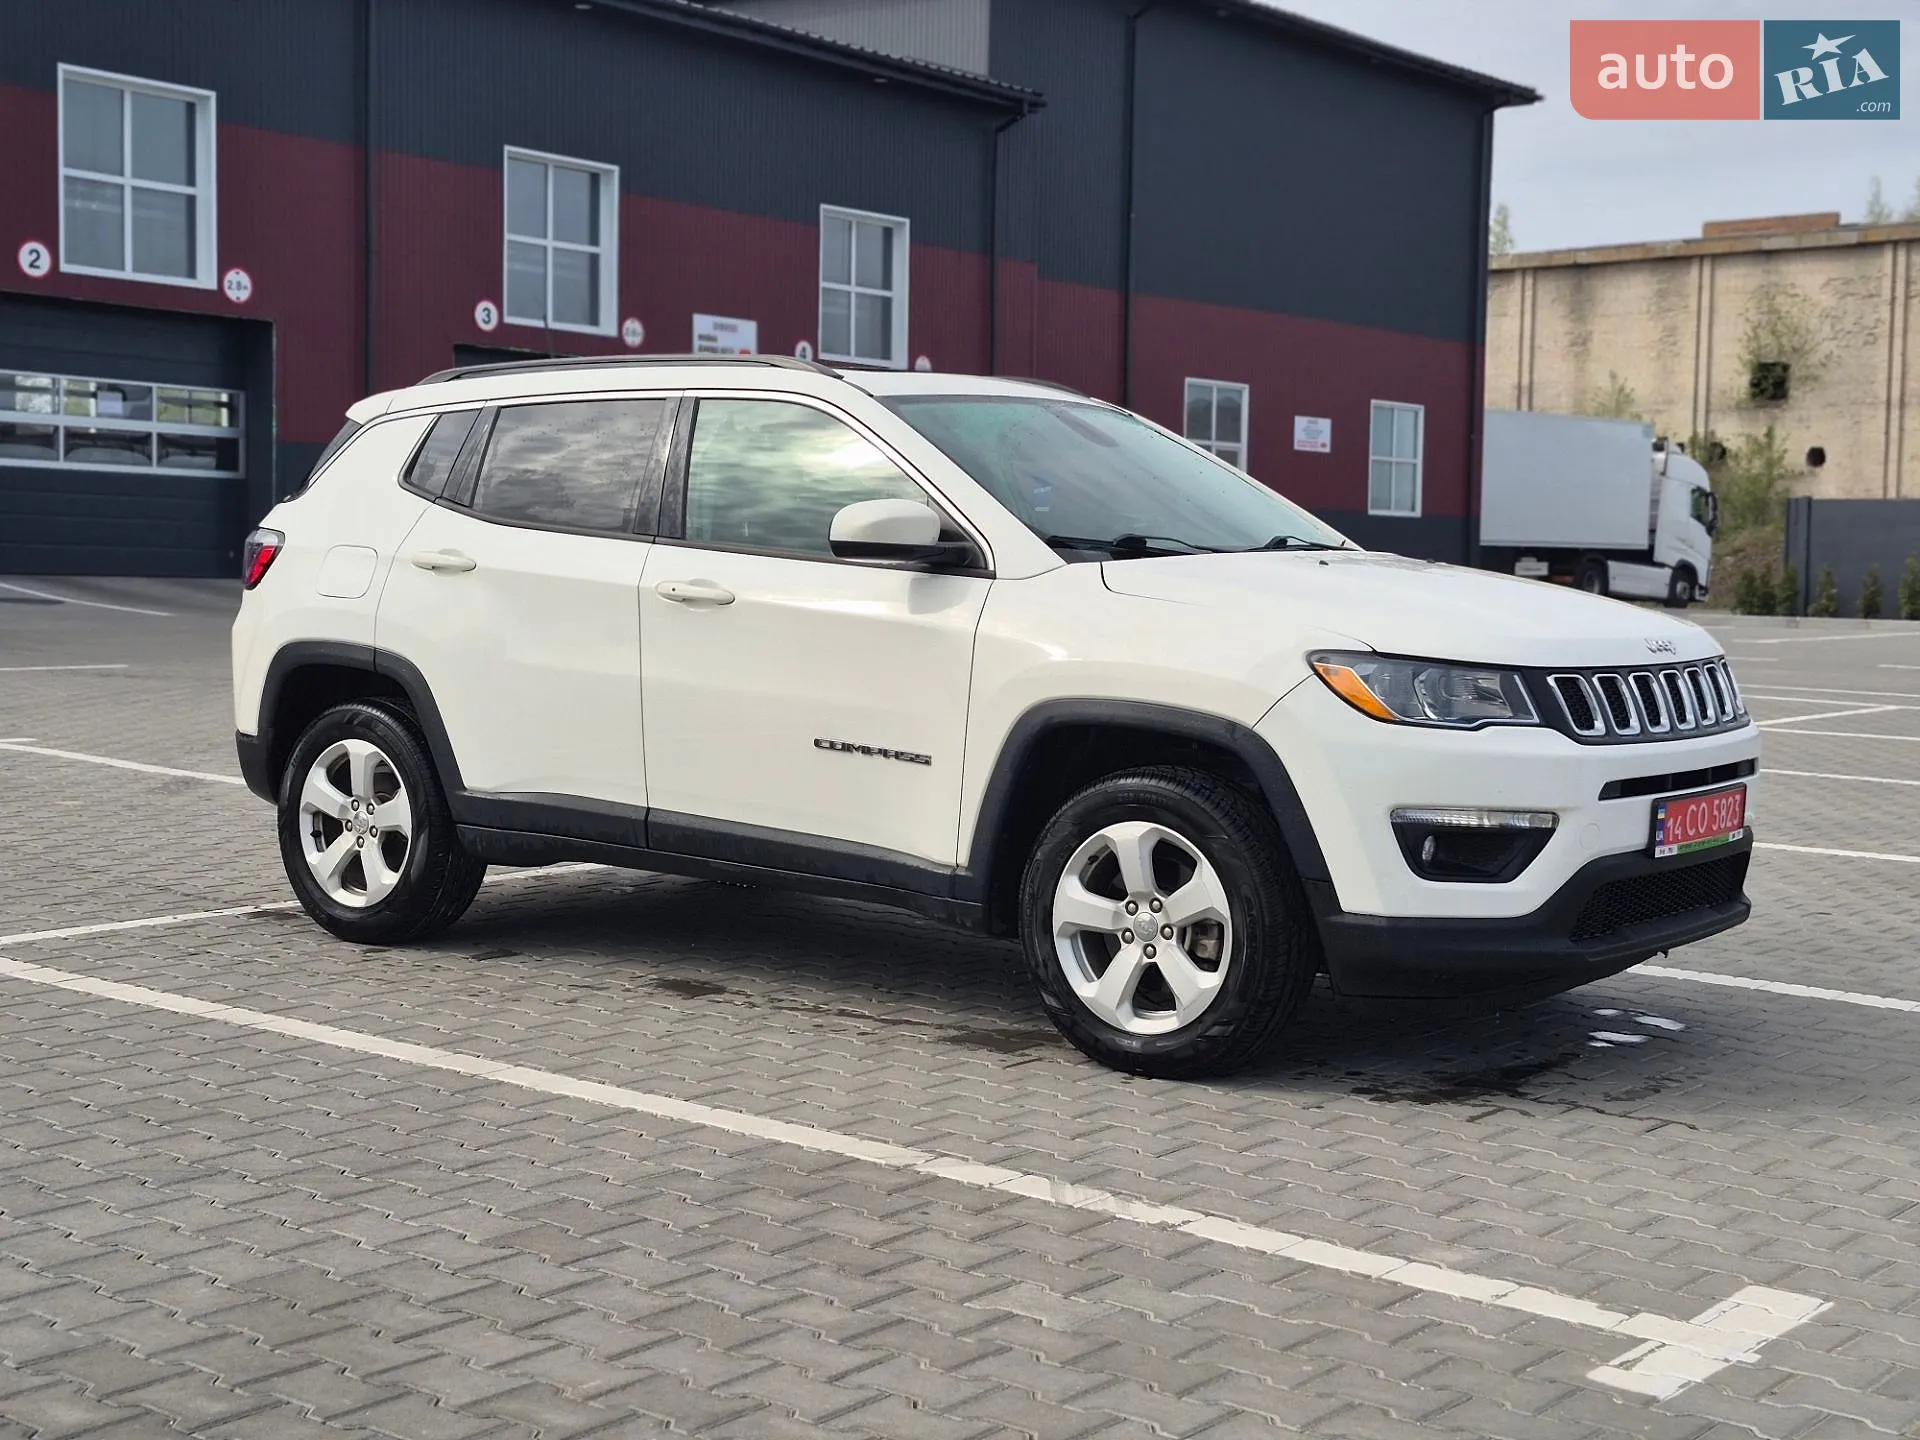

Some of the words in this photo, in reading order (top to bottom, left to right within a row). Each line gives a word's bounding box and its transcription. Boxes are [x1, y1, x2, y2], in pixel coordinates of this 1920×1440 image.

[28, 248, 41, 270] 2
[482, 306, 492, 325] 3
[813, 738, 932, 767] COMPASS
[1667, 815, 1682, 841] 14
[1686, 802, 1708, 836] CO
[1711, 794, 1742, 831] 5823
